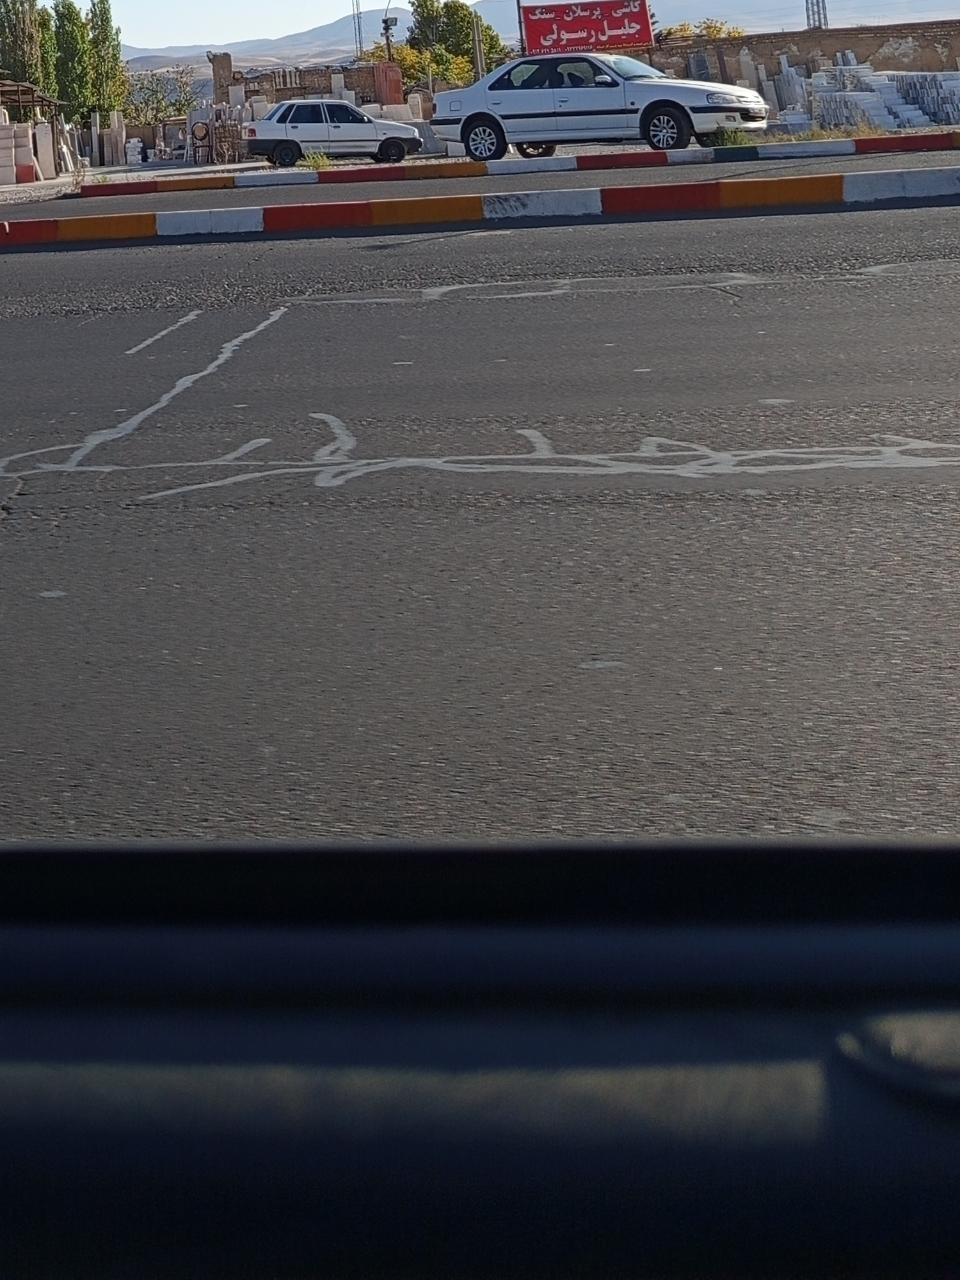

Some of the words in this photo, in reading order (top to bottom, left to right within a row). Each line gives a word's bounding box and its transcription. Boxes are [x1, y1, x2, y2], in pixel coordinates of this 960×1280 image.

[611, 0, 641, 17] کاشی
[540, 23, 596, 46] رسولی
[598, 18, 641, 41] جلیل
